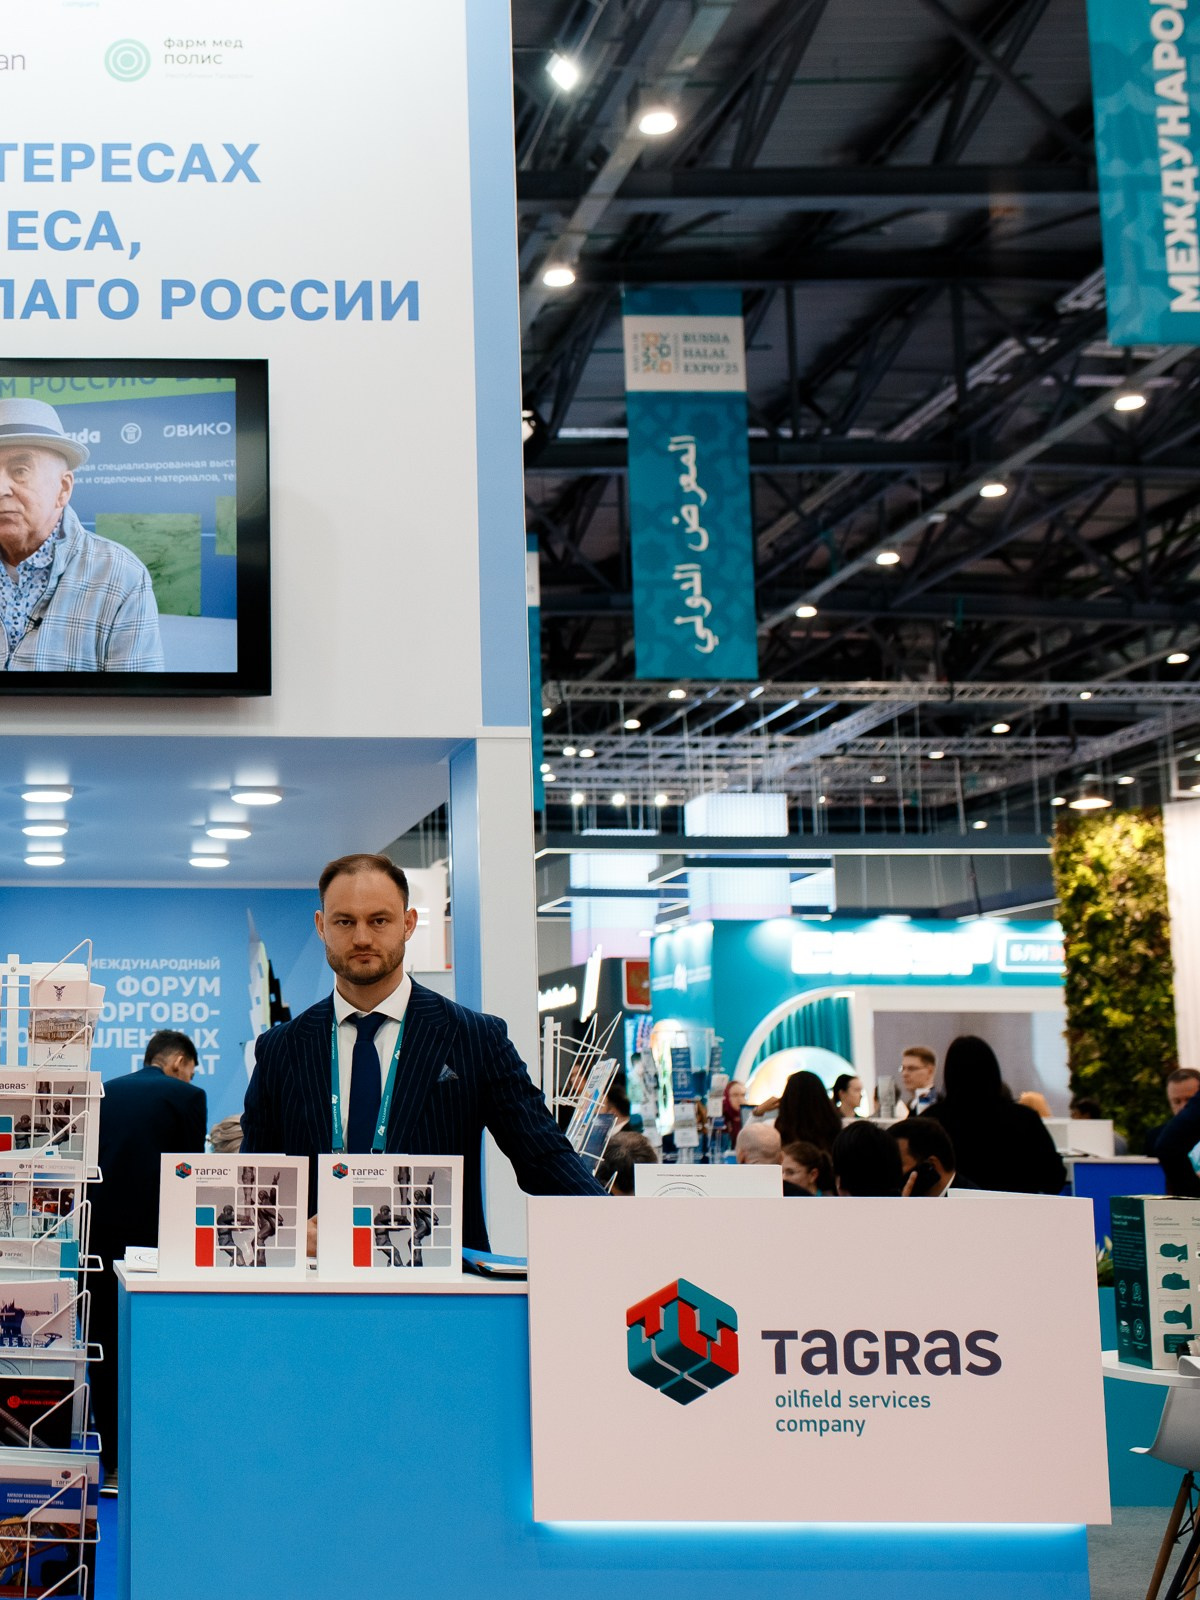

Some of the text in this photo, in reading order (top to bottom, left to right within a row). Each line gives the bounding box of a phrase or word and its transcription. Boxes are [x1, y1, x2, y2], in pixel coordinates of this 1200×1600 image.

[164, 36, 244, 51] фарм мед
[1148, 0, 1200, 313] МЕЖДУНАРО
[161, 279, 420, 321] РОССИИ
[668, 435, 719, 653] المعرض الدولي
[116, 975, 220, 997] ФОРУМ
[99, 1002, 220, 1023] ОРГОВО-
[775, 1389, 931, 1408] oilfield services
[775, 1417, 866, 1437] company
